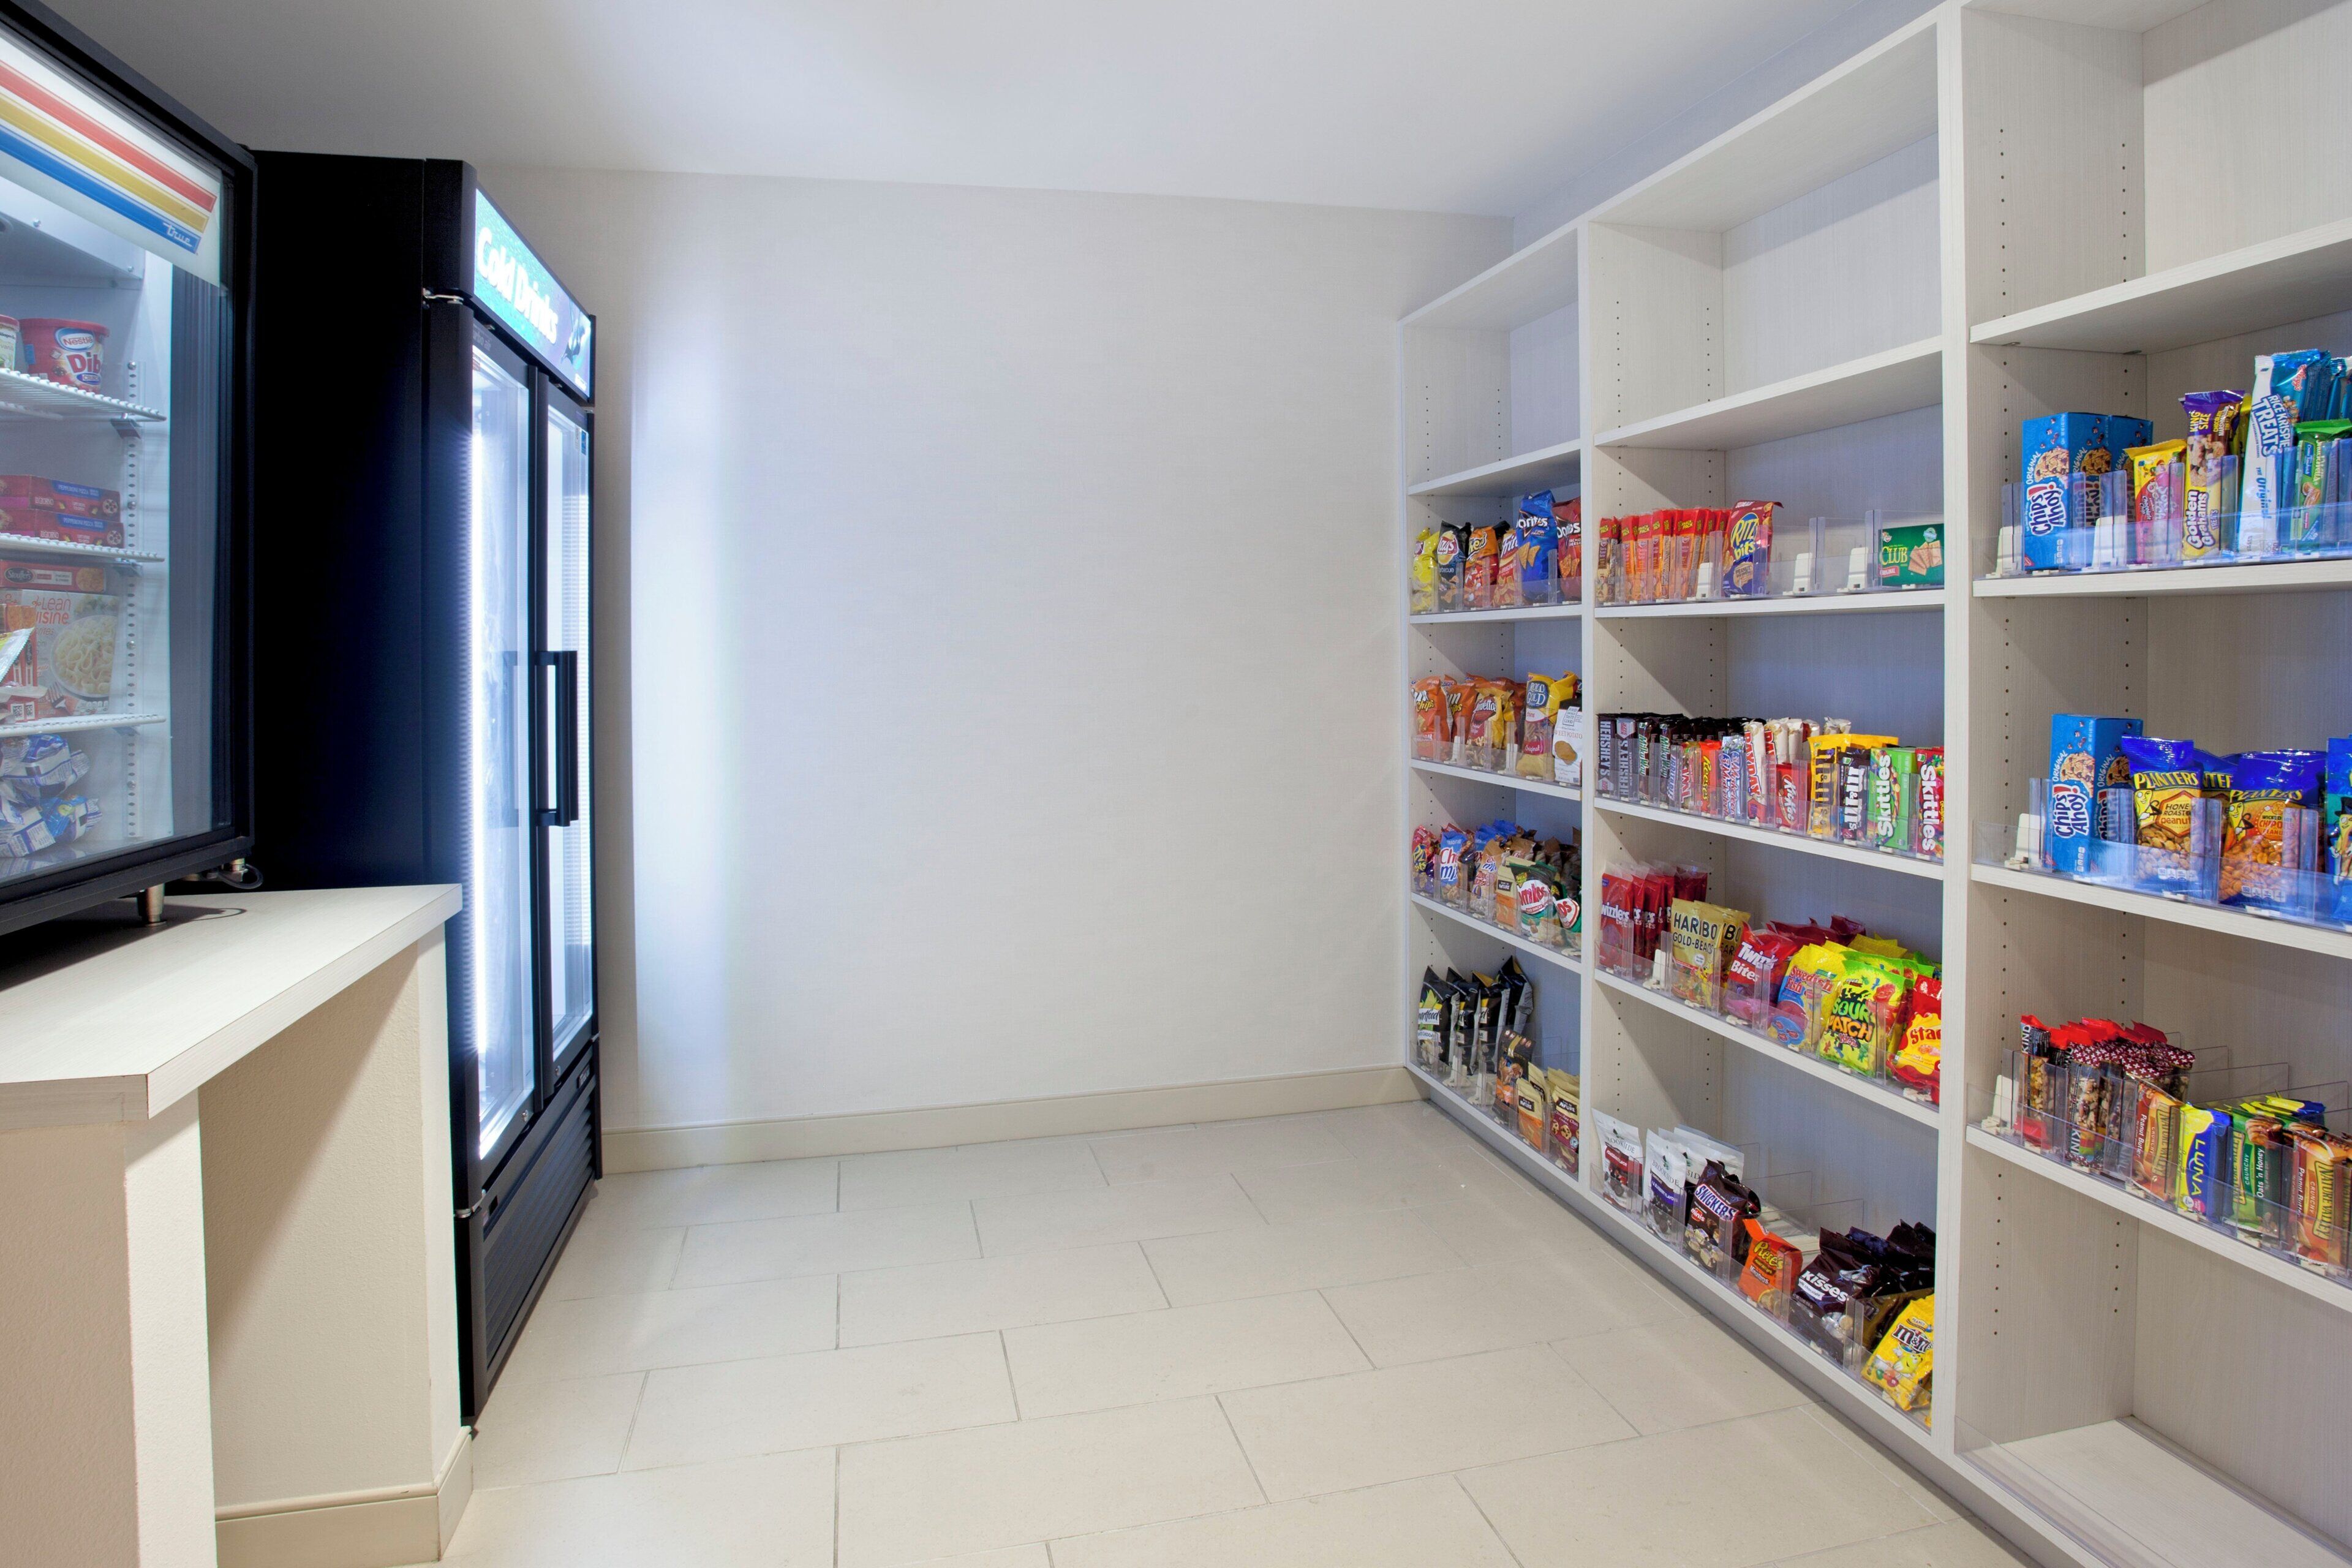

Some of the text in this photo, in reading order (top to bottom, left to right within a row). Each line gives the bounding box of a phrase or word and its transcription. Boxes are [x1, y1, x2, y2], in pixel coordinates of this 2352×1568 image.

[162, 223, 193, 246] true
[477, 227, 559, 345] Cold Drinks
[67, 353, 102, 374] Dib
[2267, 394, 2283, 415] RICE
[2190, 411, 2202, 432] KING
[2199, 413, 2212, 430] SIZE
[2213, 410, 2222, 432] CHOCOLATE
[2252, 398, 2280, 458] TREATS
[2026, 451, 2041, 484] ORIGINAL
[2073, 447, 2087, 474] RIGINAL
[2030, 493, 2052, 535] Chips
[2142, 496, 2152, 521] Chocolate
[2186, 490, 2203, 548] Golden
[2197, 491, 2215, 546] Grahams
[1516, 516, 1548, 529] oritos
[1731, 518, 1760, 547] RITZ
[1501, 533, 1518, 559] Frit
[1734, 540, 1756, 560] bits
[1880, 546, 1908, 565] CLUB
[1879, 567, 1896, 576] ORIGINAL
[41, 597, 71, 611] Lean
[37, 612, 69, 625] isine
[1526, 693, 1546, 705] GOLD
[1529, 682, 1545, 693] ROLD
[1600, 721, 1611, 777] HERSHEY'S
[1639, 734, 1649, 776] Milky Way
[1660, 735, 1670, 778] Milky Way
[1618, 739, 1629, 796] HERSHEY'S
[1744, 731, 1761, 796] PAYDAY
[2052, 750, 2068, 782] ORIGINAL
[2097, 753, 2115, 788] ORIGINAL
[1681, 766, 1692, 803] TWI
[2134, 771, 2199, 790] PLANTERS
[1876, 755, 1893, 837] Skittles
[1920, 764, 1939, 851] Skittles
[2053, 794, 2074, 837] Chips
[1440, 848, 1458, 864] Ch
[1602, 902, 1630, 922] wizzlers
[1673, 912, 1717, 940] HARIBO
[1673, 932, 1714, 954] GOLD-BEARS
[1730, 960, 1760, 982] Bites
[1790, 965, 1833, 993] Swedish
[1785, 978, 1803, 993] Fish
[1833, 997, 1871, 1022] SOUR
[1825, 1015, 1874, 1042] PATCH
[1910, 1026, 1941, 1045] Star
[2021, 1025, 2031, 1054] KIND
[2070, 1128, 2081, 1155] KIN
[2136, 1136, 2144, 1158] Butter
[2192, 1139, 2206, 1195] LUNA
[2320, 1165, 2334, 1206] NATURE
[1691, 1208, 1705, 1222] minis
[1695, 1185, 1738, 1221] SNICKERS
[1754, 1241, 1784, 1270] Reese's
